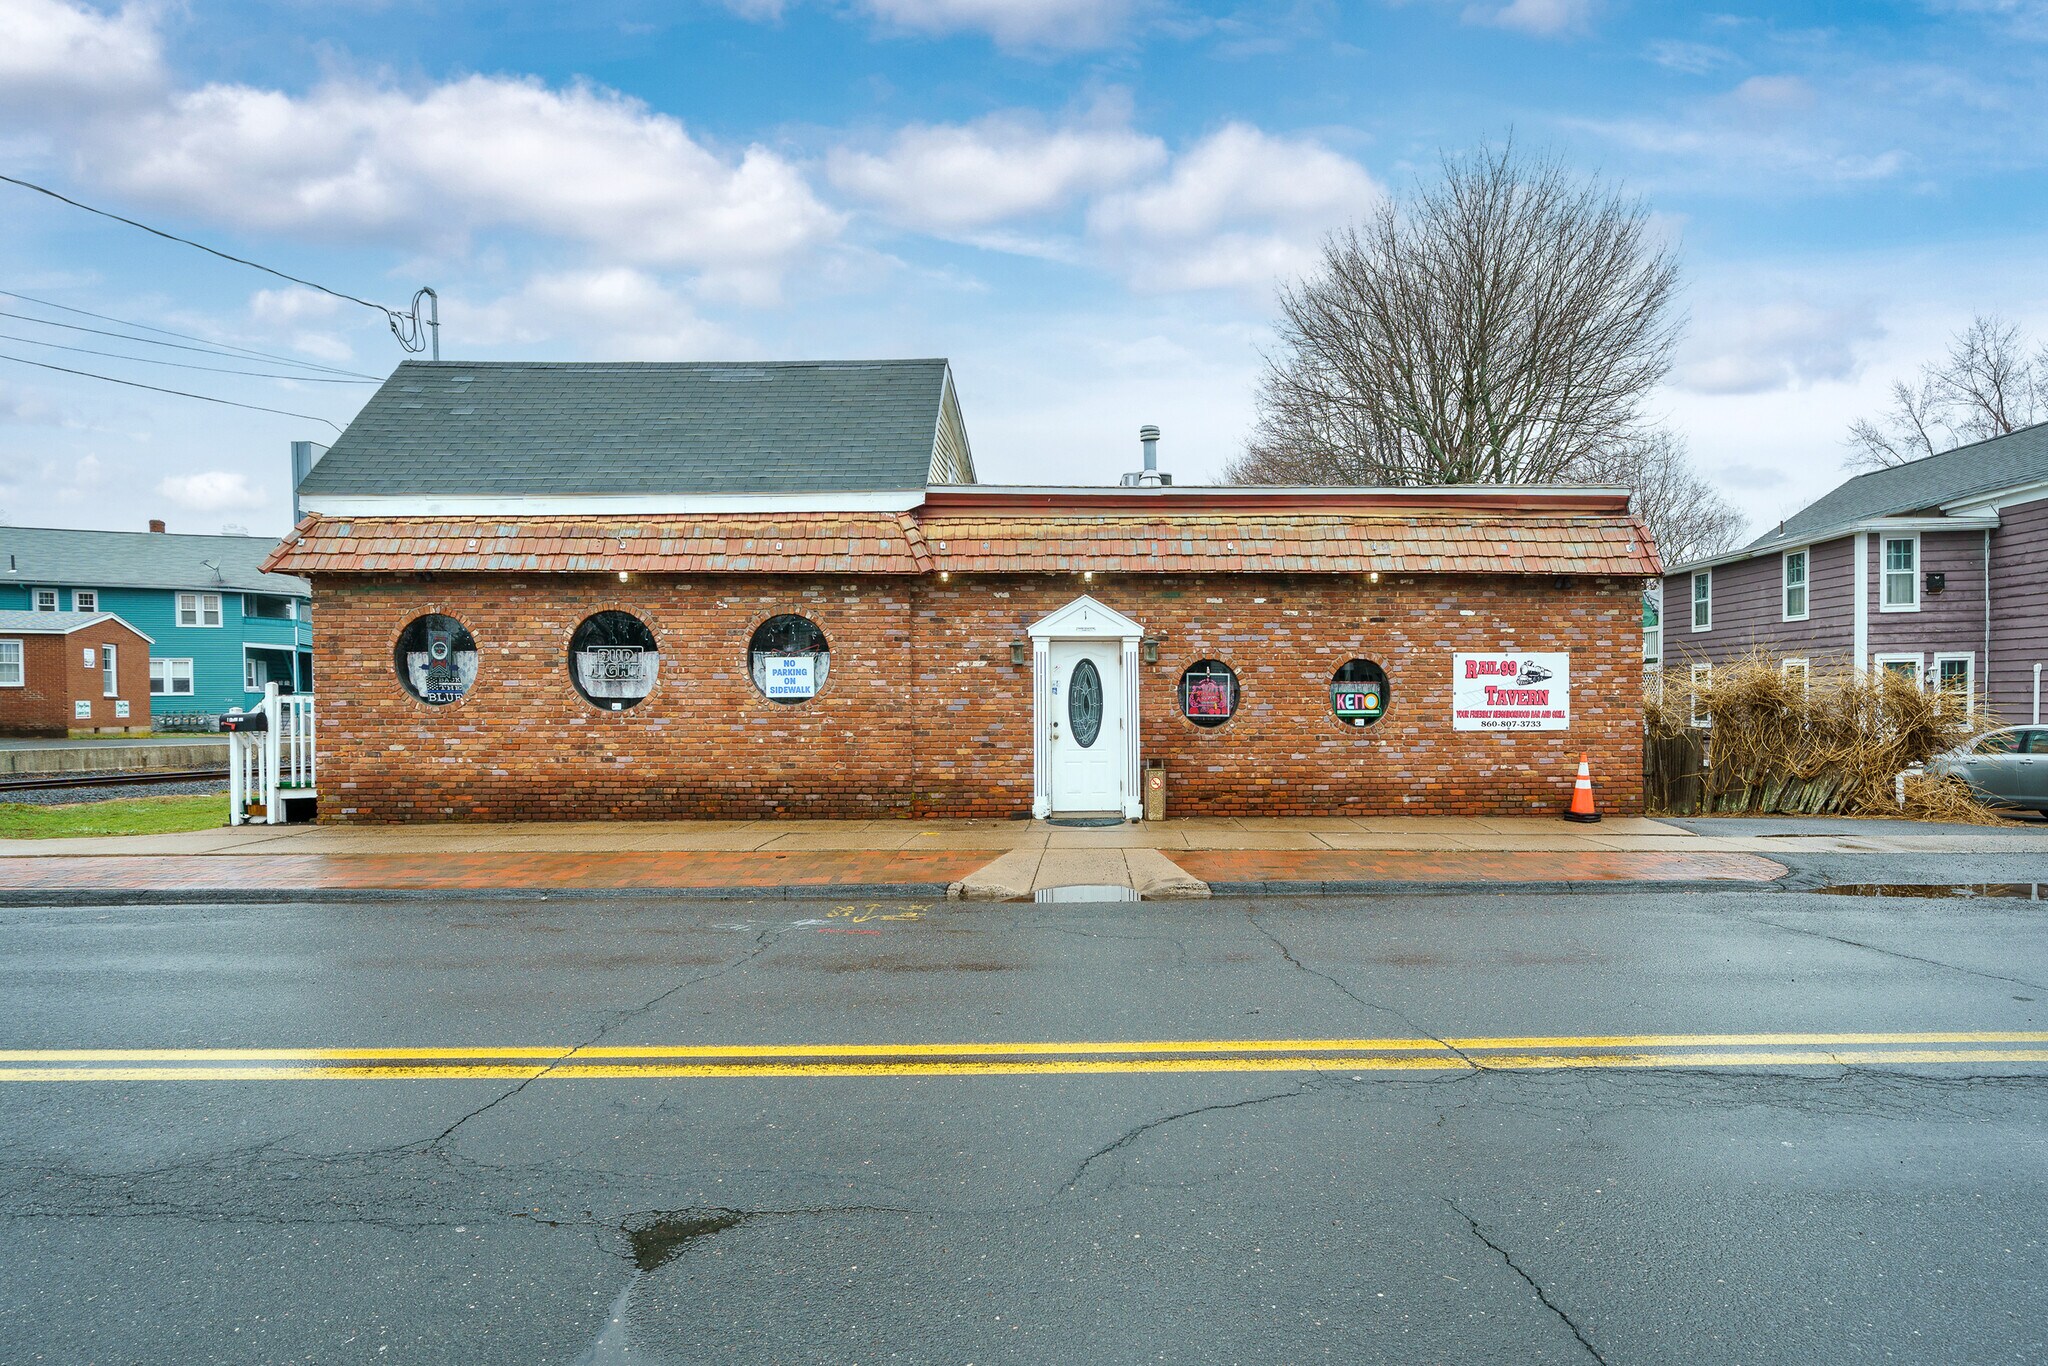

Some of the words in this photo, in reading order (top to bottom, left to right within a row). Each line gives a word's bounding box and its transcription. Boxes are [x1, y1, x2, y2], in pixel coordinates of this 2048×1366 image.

[597, 648, 634, 663] BUD
[783, 659, 796, 667] NO
[591, 662, 641, 678] LIGHT
[772, 668, 807, 676] PARKING
[1465, 660, 1500, 679] RAIL
[1500, 660, 1517, 676] 99
[783, 677, 796, 685] ON
[770, 686, 811, 694] SIDEWALK
[1485, 685, 1549, 705] TAVERN
[1336, 693, 1379, 710] KENO
[1456, 710, 1469, 718] YOUR
[1481, 720, 1542, 728] 860-807-3733
